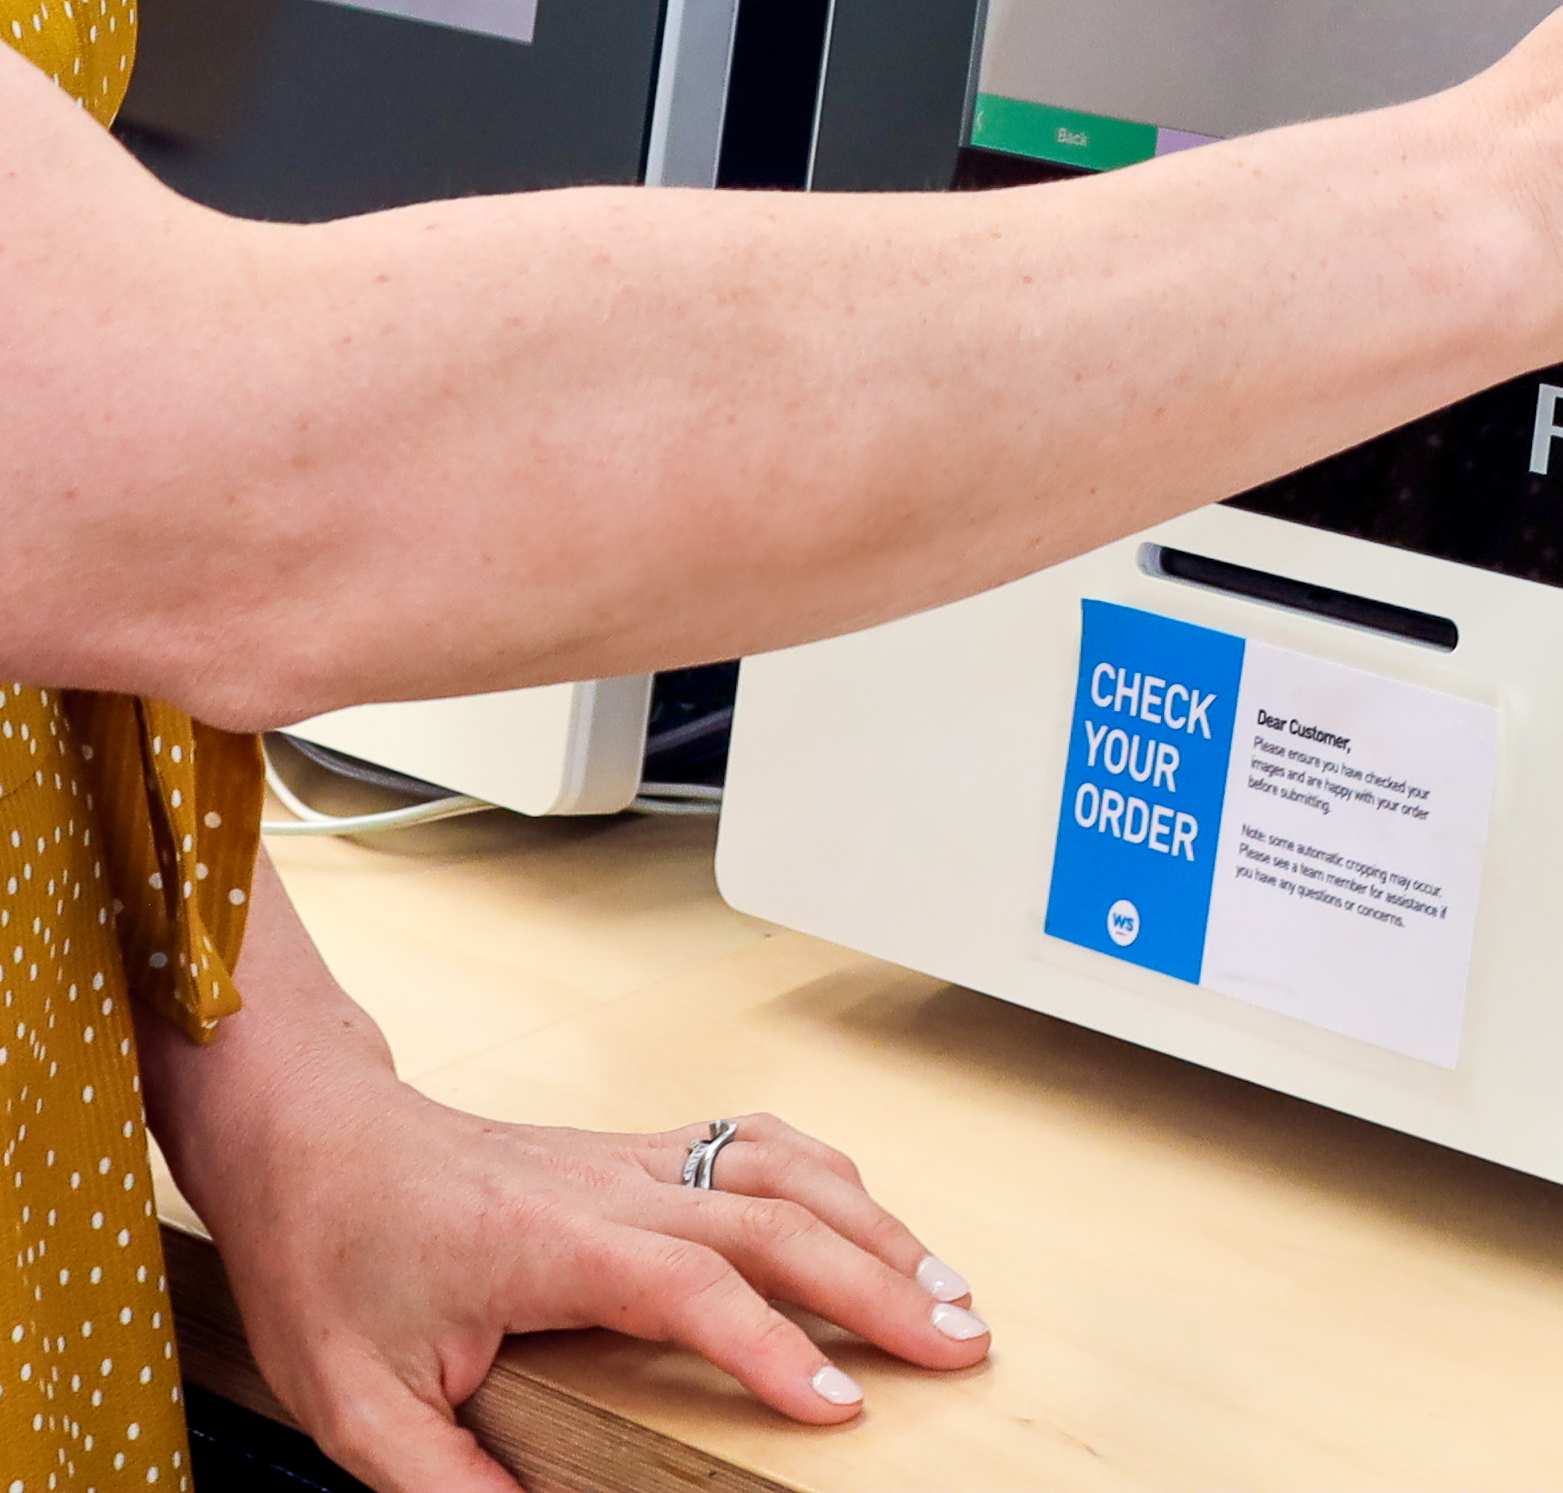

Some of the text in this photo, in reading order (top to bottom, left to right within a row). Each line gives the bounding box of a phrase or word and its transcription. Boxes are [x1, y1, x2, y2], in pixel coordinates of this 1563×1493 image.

[1056, 127, 1088, 146] Back
[1090, 662, 1217, 740] CHECK
[1257, 709, 1352, 754] Dear Customer,
[1085, 720, 1180, 792] YOUR
[1247, 775, 1278, 797] before
[1253, 736, 1431, 801] Please ensure you have checked your
[1251, 758, 1430, 821] images and are happy with your order
[1074, 782, 1199, 861] ORDER
[1235, 865, 1253, 879] you
[1254, 868, 1277, 887] have
[1279, 879, 1296, 895] any
[1297, 885, 1342, 909] questions
[1344, 900, 1356, 911] or
[1238, 842, 1271, 864] Please
[1273, 857, 1290, 871] see
[1300, 864, 1325, 881] team
[1326, 874, 1368, 894] member
[1369, 884, 1384, 899] for
[1386, 893, 1438, 918] assistance
[1439, 905, 1448, 920] if
[1268, 835, 1295, 851] some
[1297, 843, 1345, 868] automatic
[1346, 858, 1388, 884] cropping
[1389, 872, 1411, 891] may
